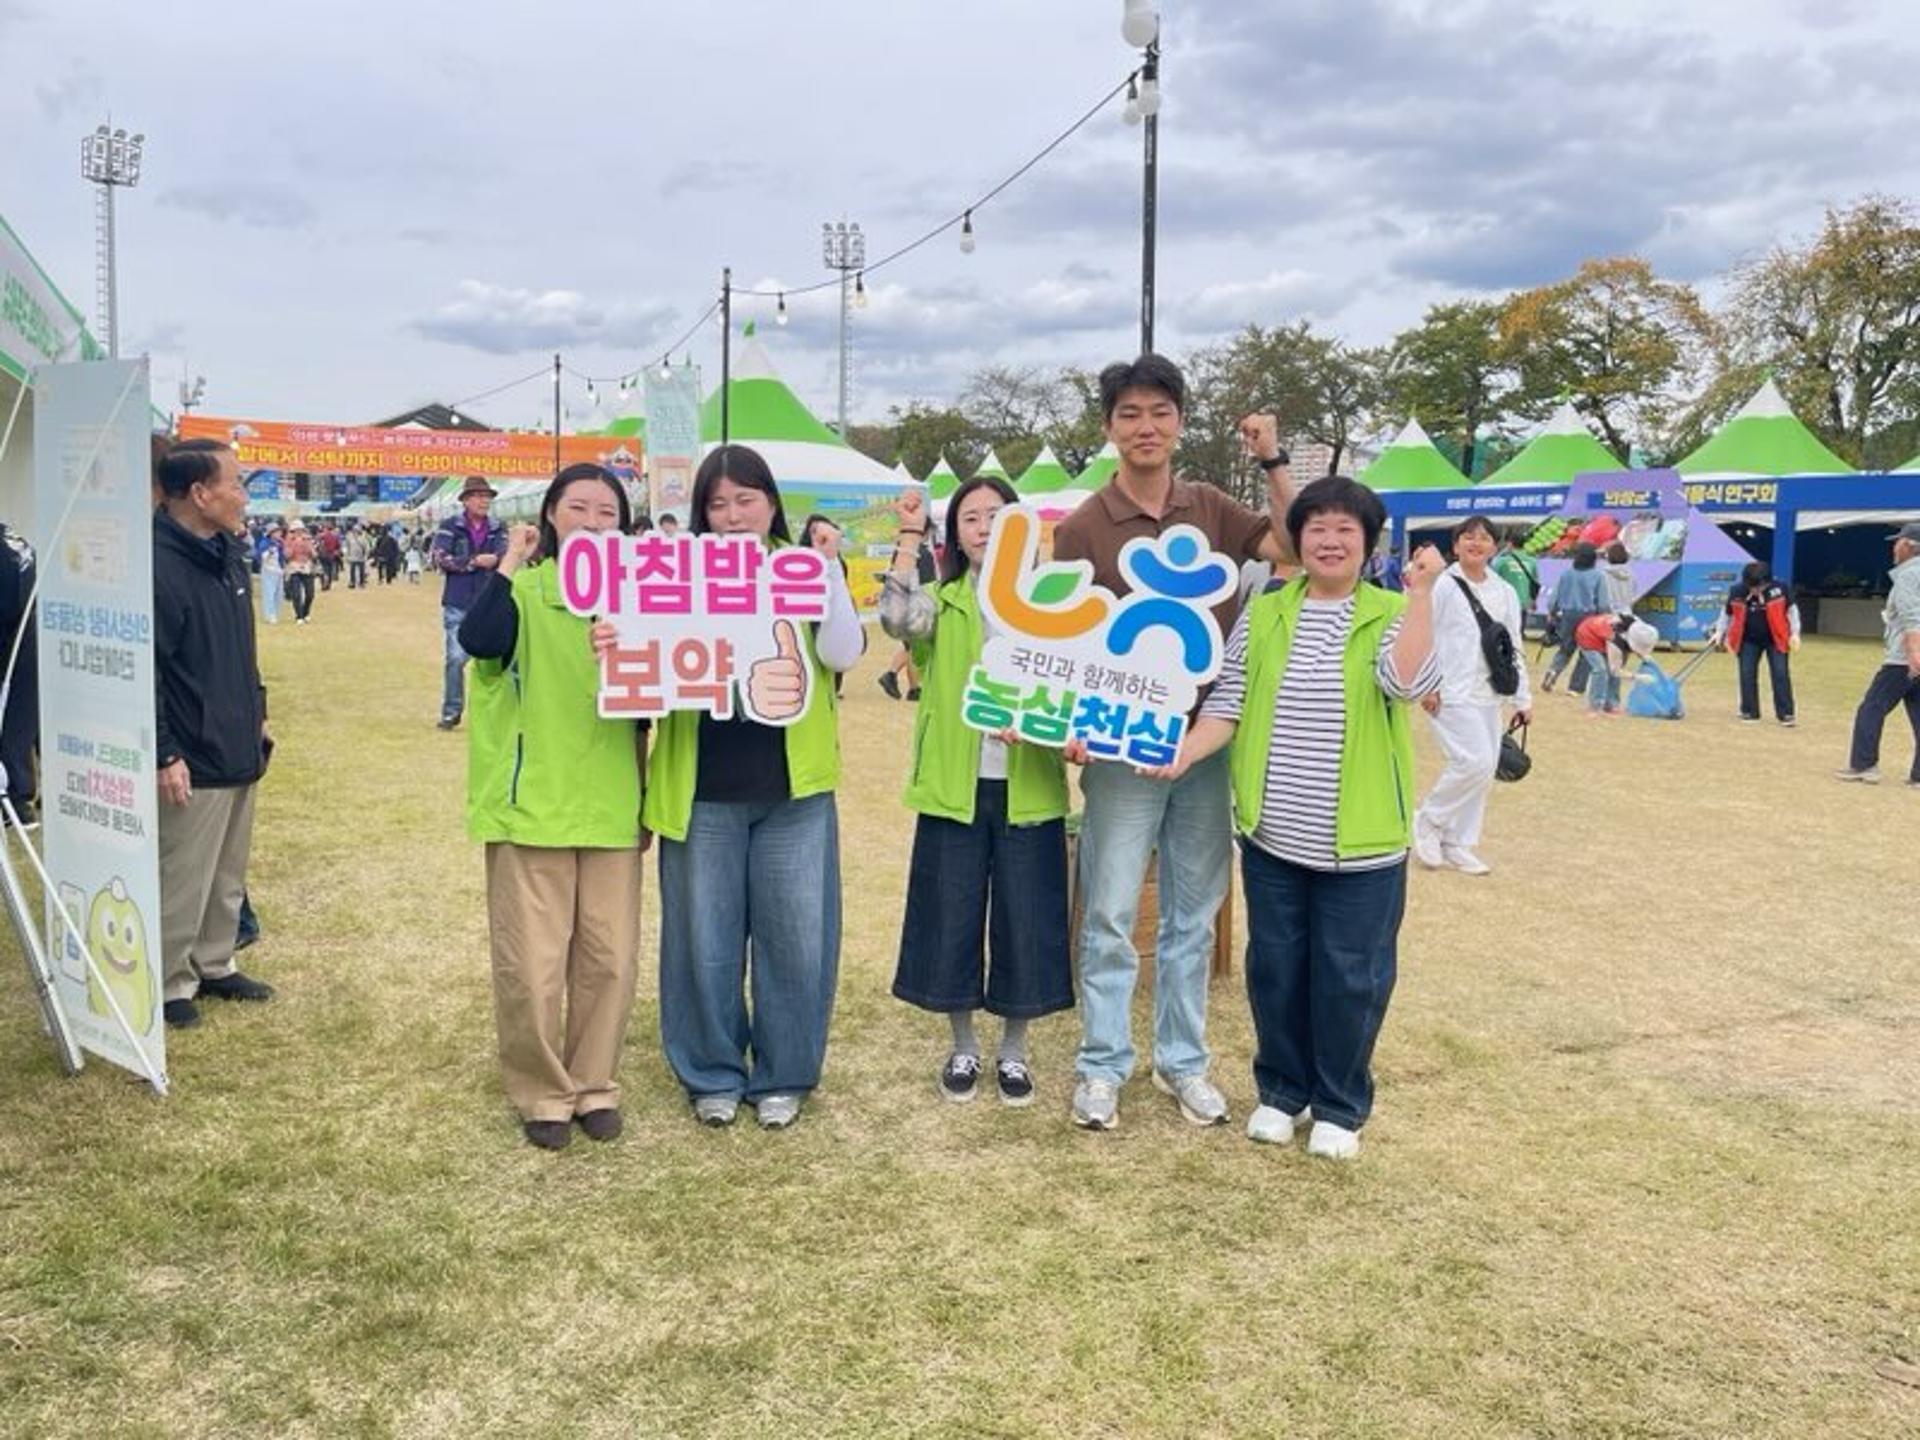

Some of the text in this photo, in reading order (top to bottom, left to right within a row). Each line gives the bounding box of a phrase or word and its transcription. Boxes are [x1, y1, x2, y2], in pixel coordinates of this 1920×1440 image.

[564, 537, 826, 615] 아침밥은
[604, 638, 734, 714] 보약
[1010, 648, 1169, 704] 국민과 함께하는
[965, 669, 1183, 766] 농심천심
